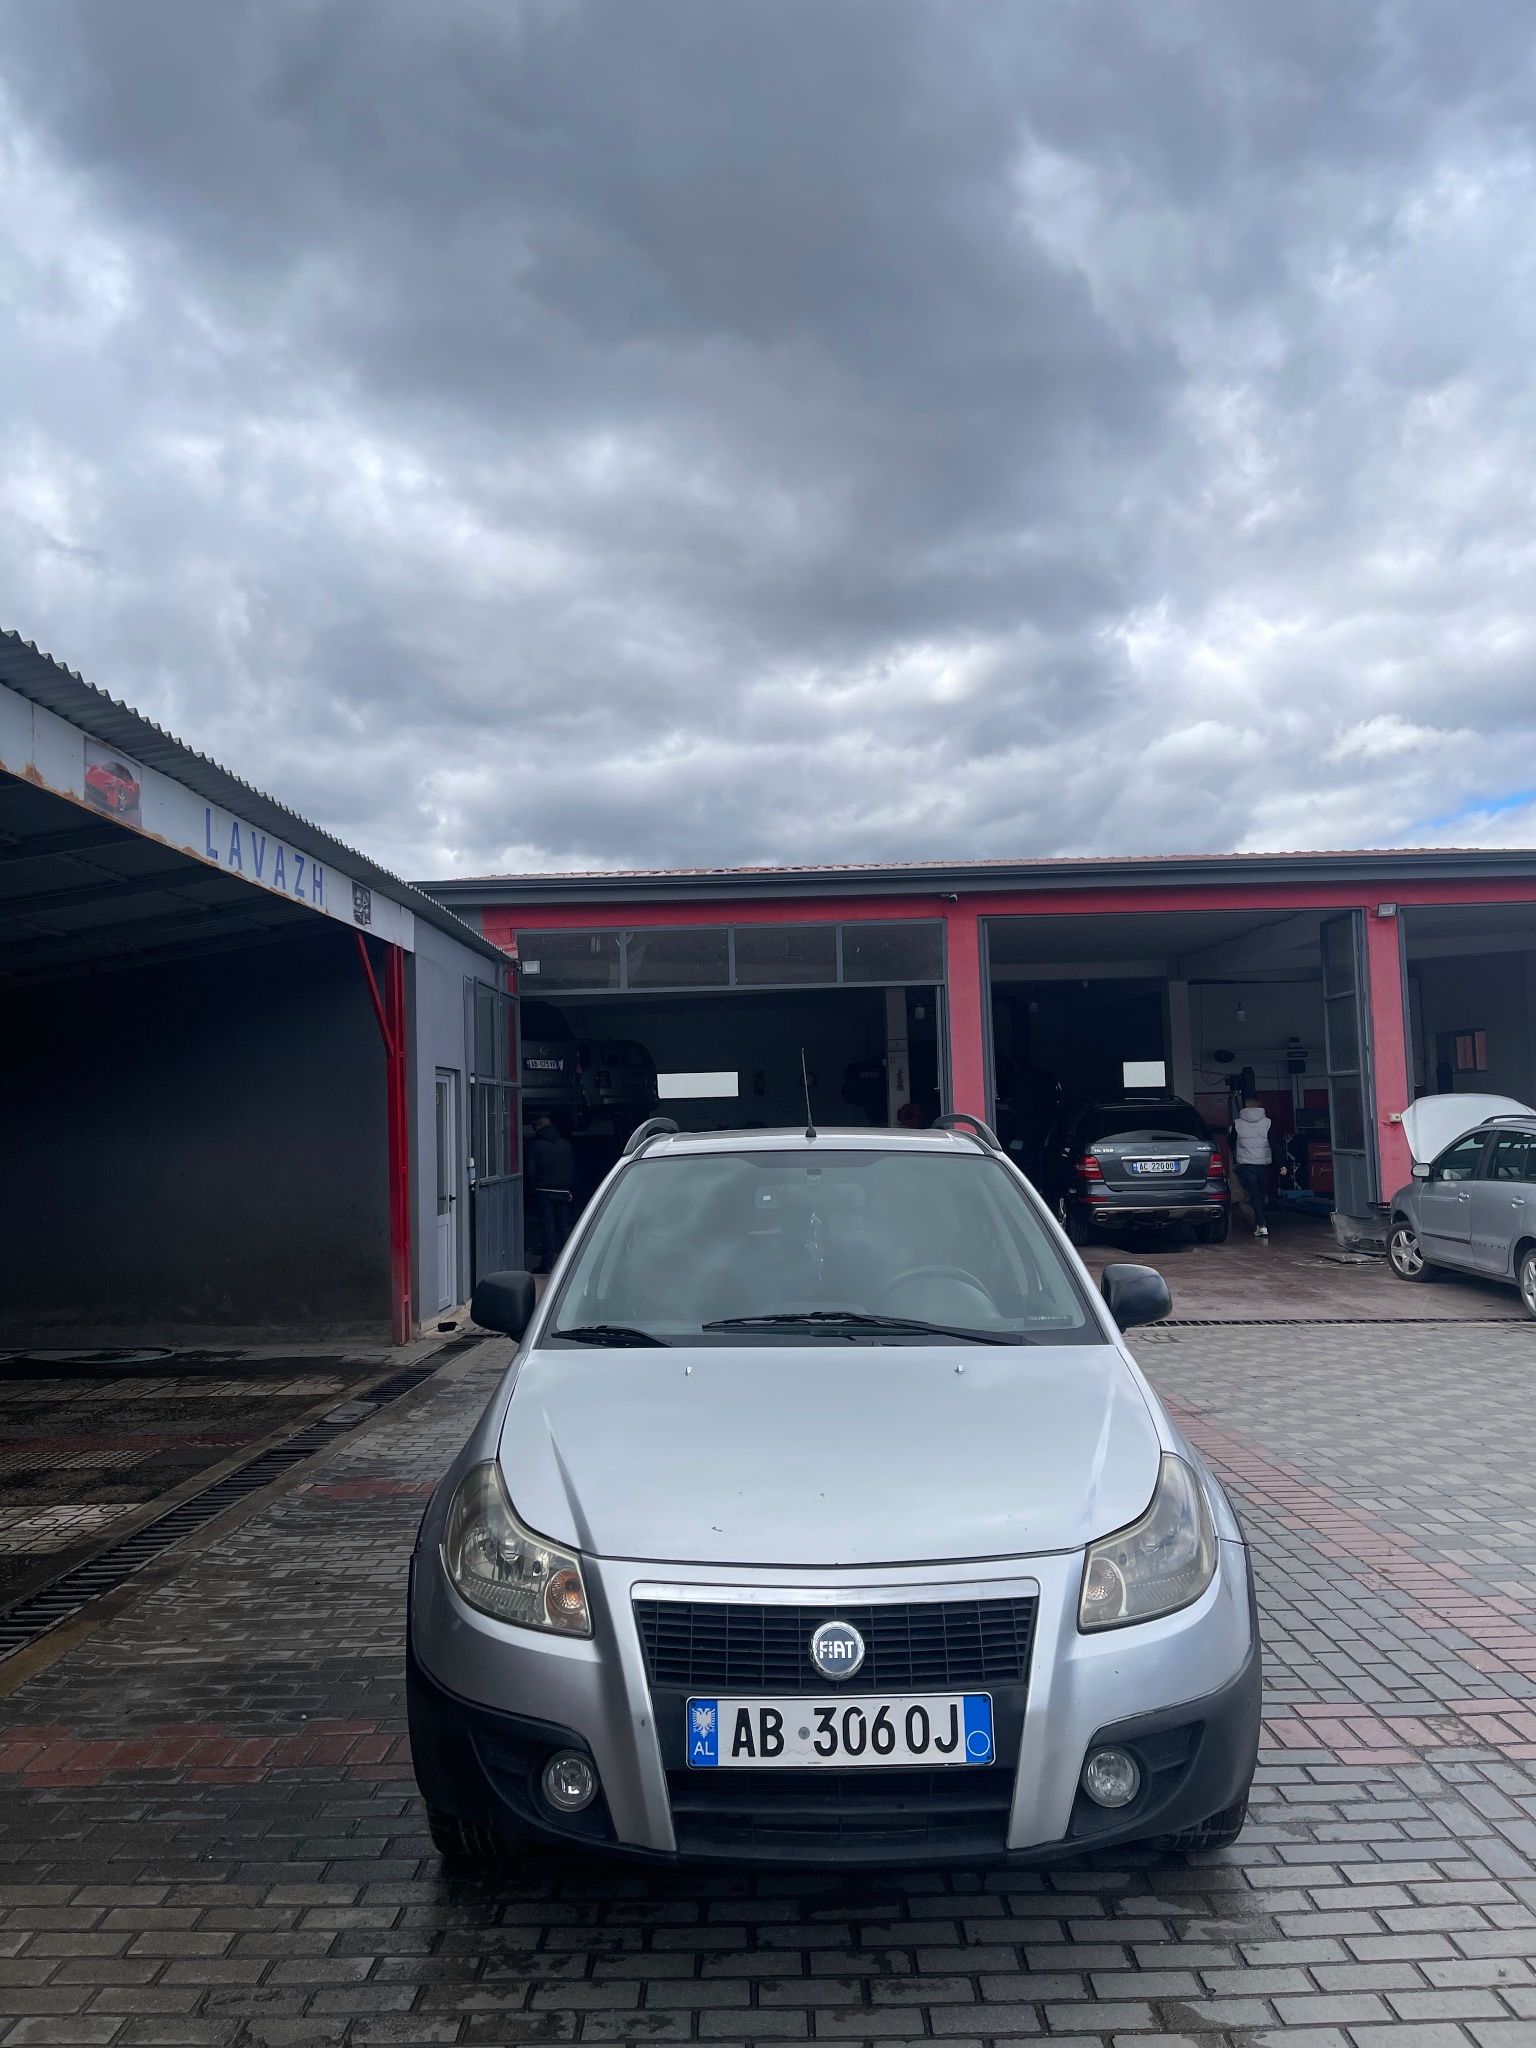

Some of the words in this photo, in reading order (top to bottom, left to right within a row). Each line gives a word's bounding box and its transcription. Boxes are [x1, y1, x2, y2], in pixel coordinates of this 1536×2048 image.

[205, 807, 323, 906] LAVAZH
[818, 1640, 855, 1659] FIAT
[693, 1740, 715, 1756] AL
[731, 1707, 785, 1758] AB
